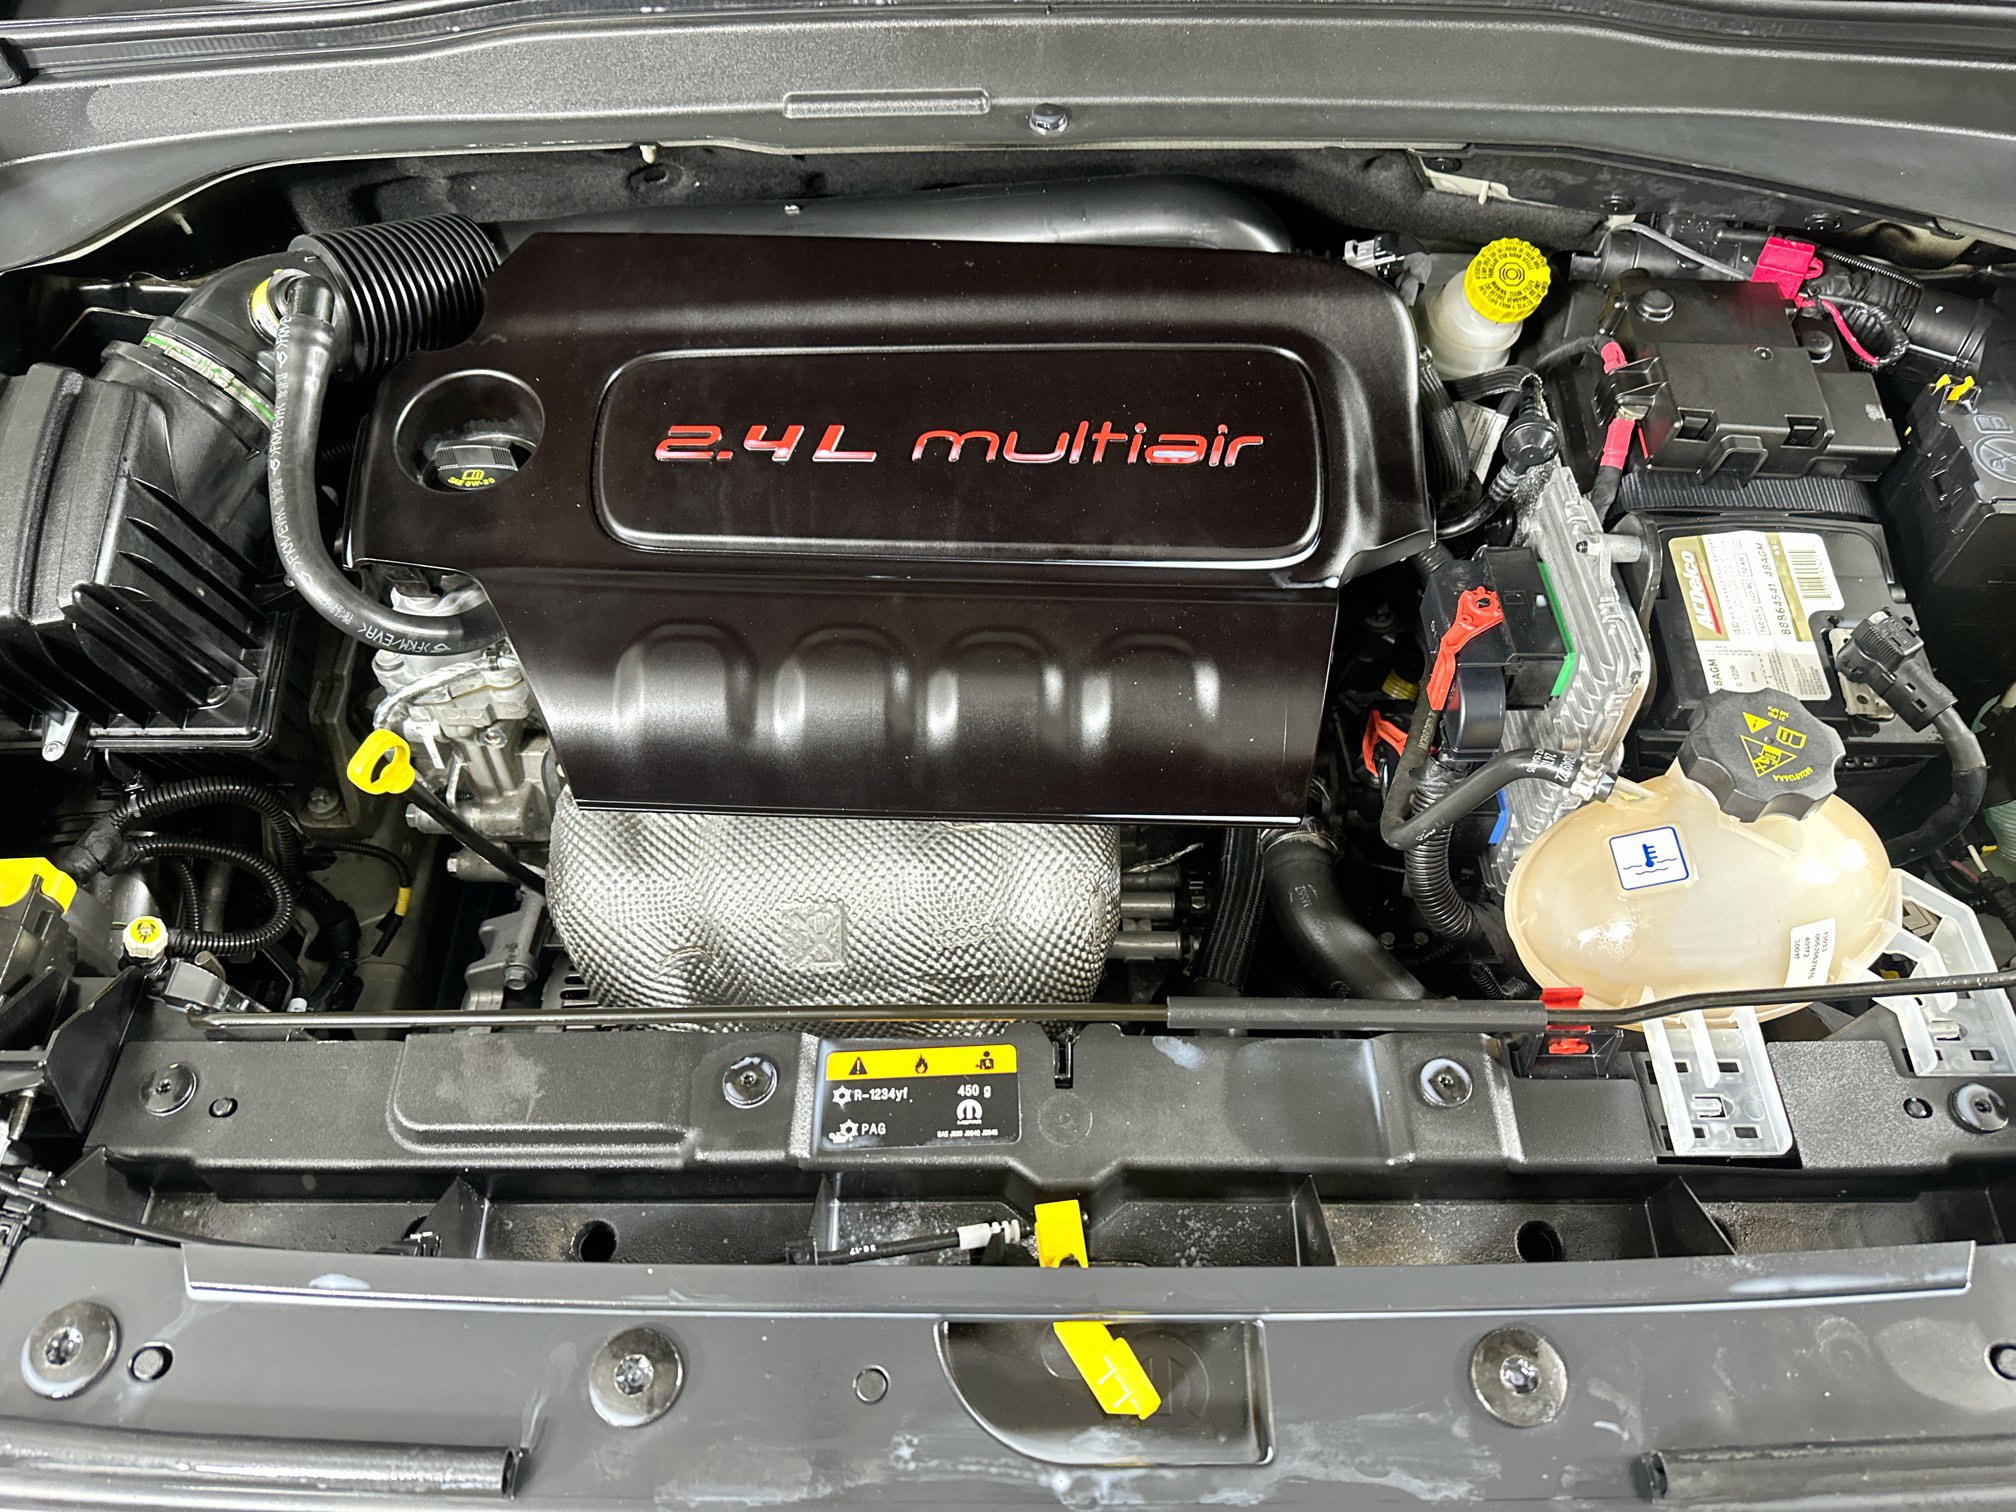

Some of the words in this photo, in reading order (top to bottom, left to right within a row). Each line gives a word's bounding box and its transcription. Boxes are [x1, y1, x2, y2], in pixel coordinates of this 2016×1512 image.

[912, 419, 1264, 468] multiair
[1755, 542, 1773, 577] 48AGM
[1681, 550, 1717, 631] ACDelco
[1768, 583, 1791, 635] 88864541
[1708, 659, 1723, 691] 8AGM
[853, 1086, 908, 1102] R-1234yf
[957, 1084, 979, 1097] 450
[983, 1085, 991, 1098] g
[861, 1122, 886, 1135] PAG
